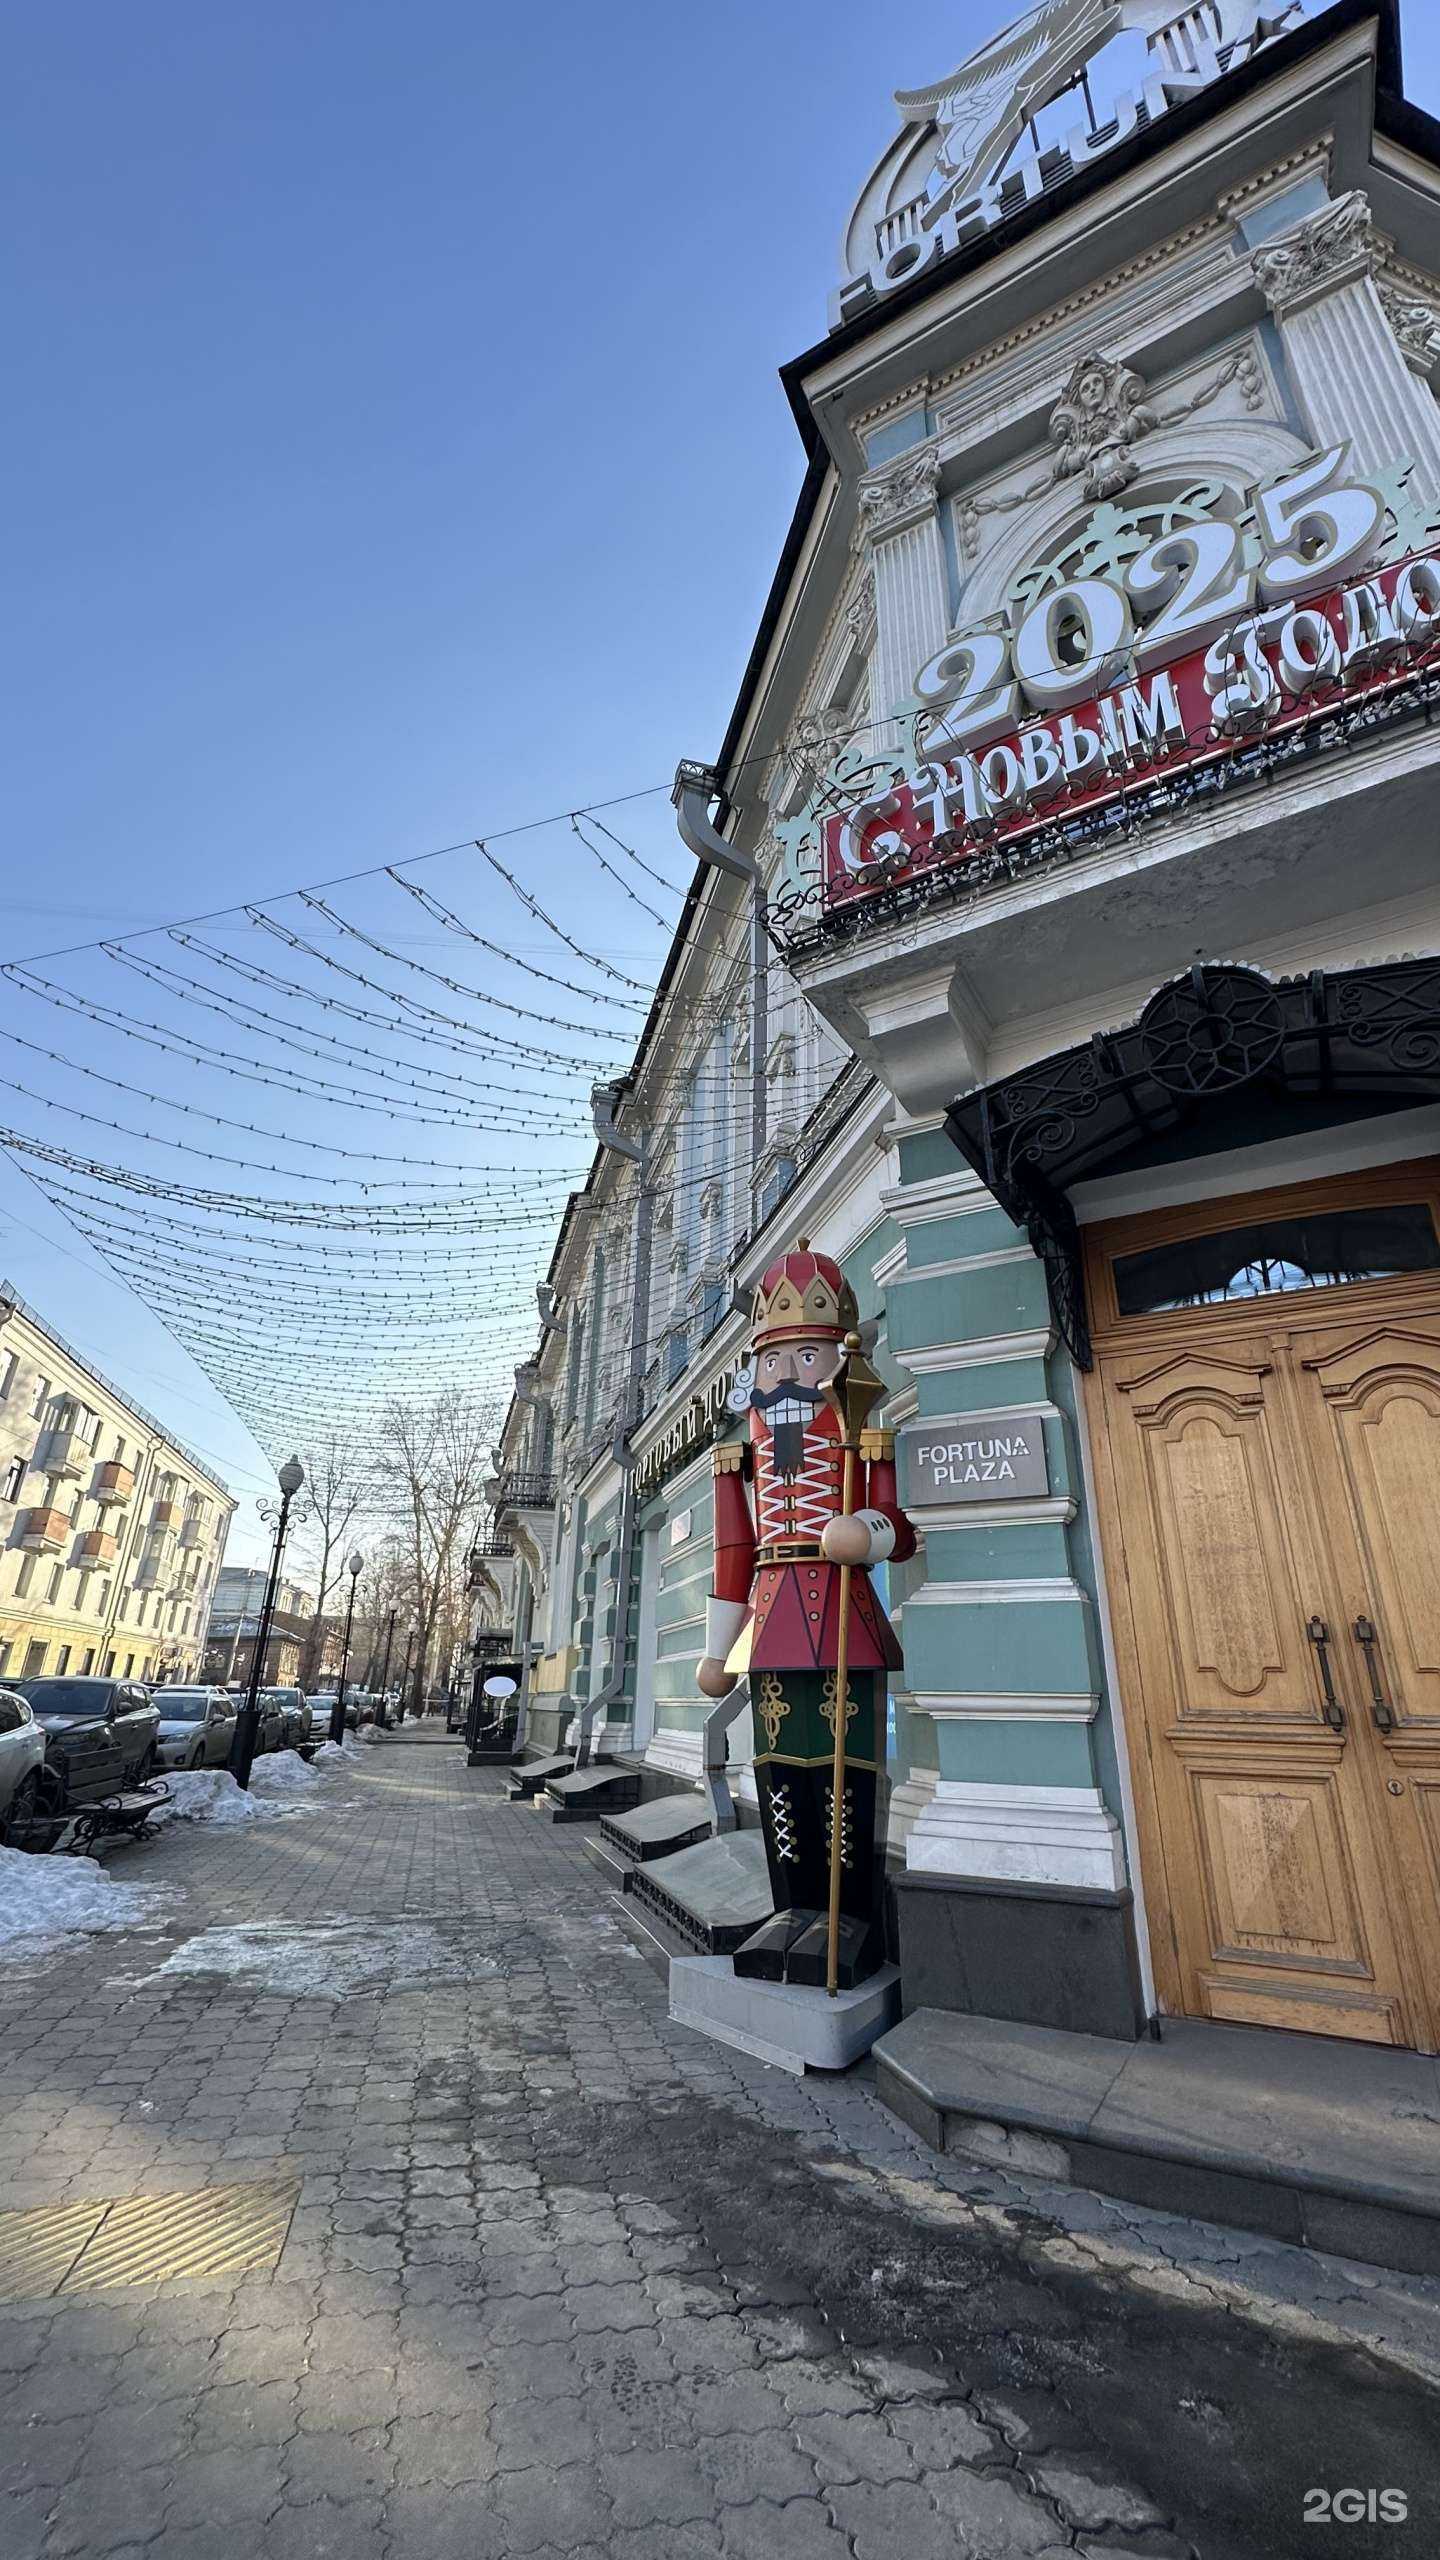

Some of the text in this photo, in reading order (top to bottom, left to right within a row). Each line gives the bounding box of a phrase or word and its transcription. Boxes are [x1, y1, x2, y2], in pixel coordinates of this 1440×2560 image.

[826, 3, 1312, 334] FORTUNA
[911, 438, 1386, 756] 2025
[629, 1395, 698, 1496] ТОРГОВЫЙ
[917, 1436, 1031, 1466] FORTUNA
[934, 1460, 1016, 1486] PLAZA
